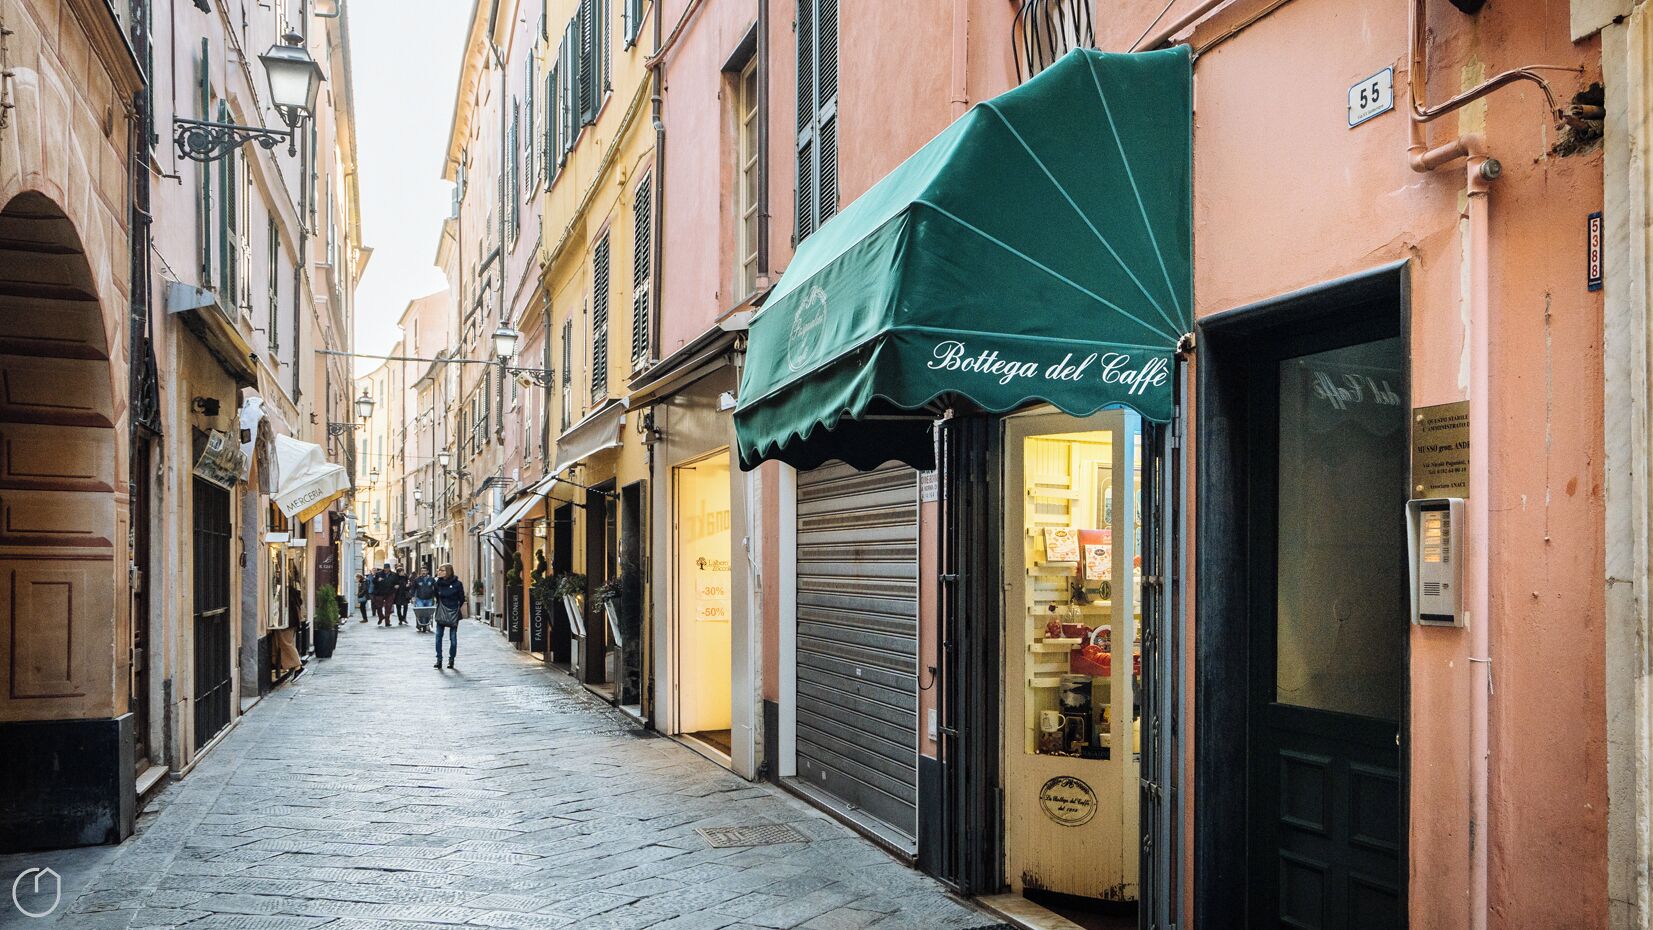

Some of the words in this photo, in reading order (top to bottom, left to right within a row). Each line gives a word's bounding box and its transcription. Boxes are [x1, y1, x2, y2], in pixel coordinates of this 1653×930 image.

[1359, 81, 1380, 110] 55
[1591, 220, 1599, 278] 5388
[927, 340, 1038, 385] Bottega
[1044, 353, 1098, 381] del
[1100, 352, 1170, 395] Caffè
[286, 487, 323, 512] MERCERIA
[702, 586, 724, 596] -30%
[534, 600, 544, 641] FALCONER
[701, 607, 725, 617] -50%
